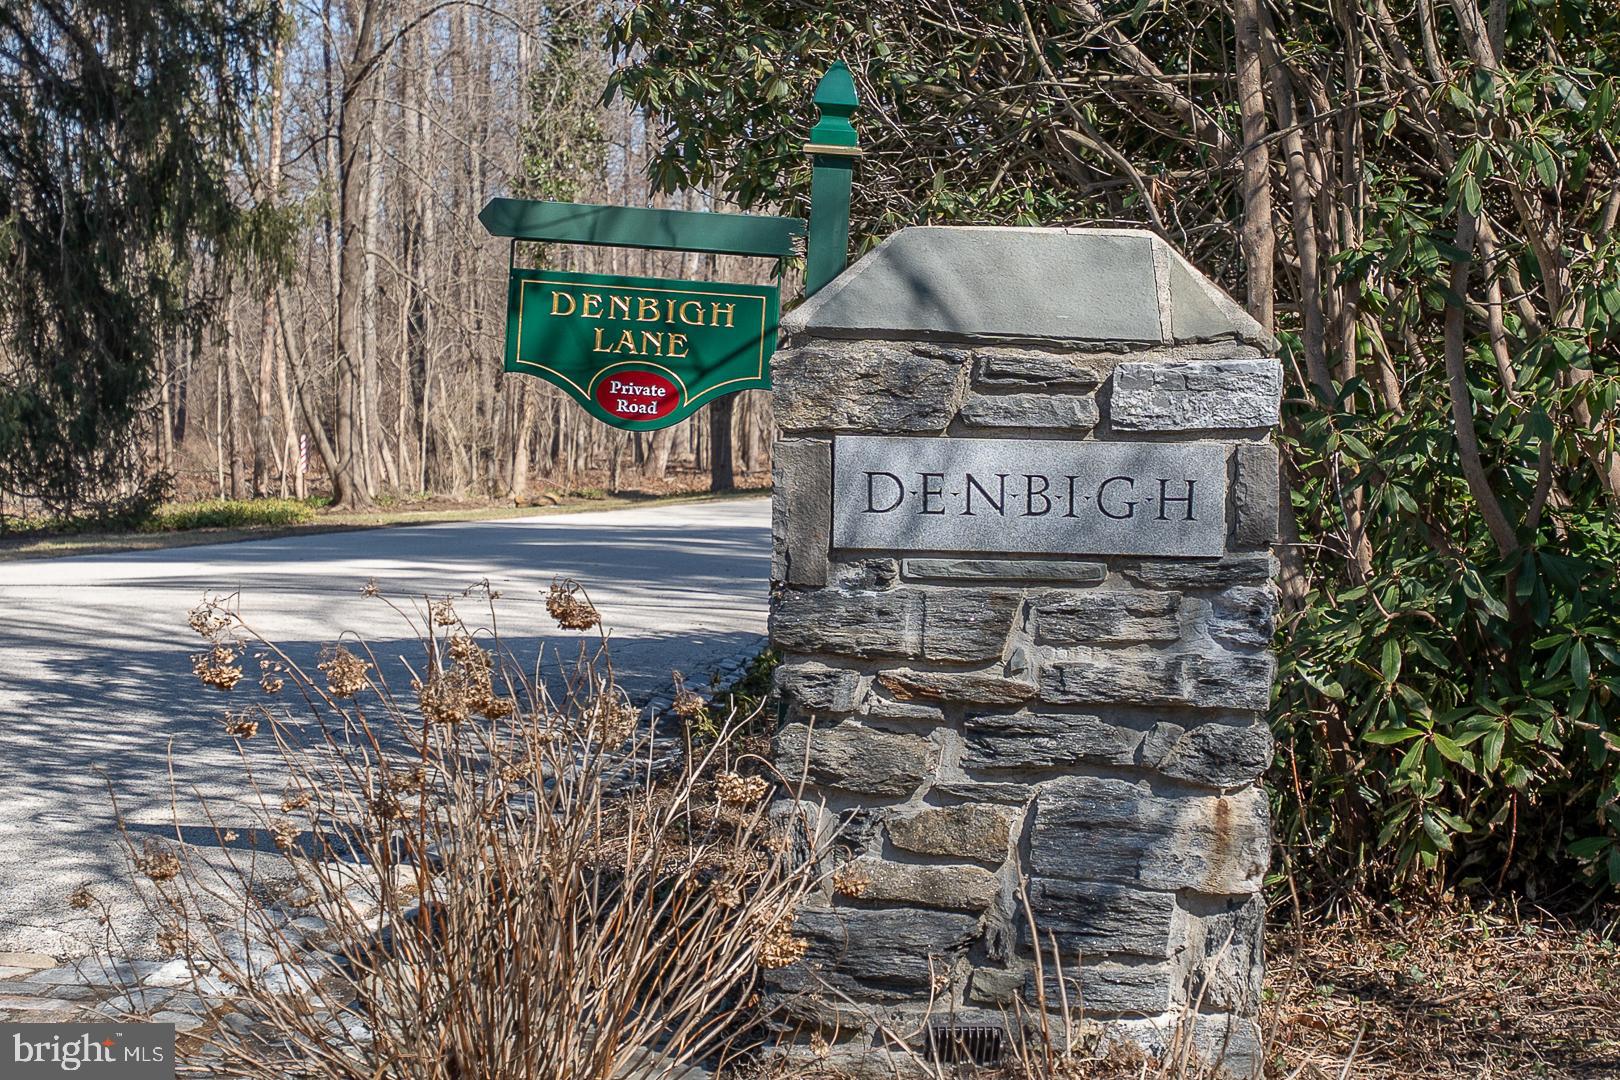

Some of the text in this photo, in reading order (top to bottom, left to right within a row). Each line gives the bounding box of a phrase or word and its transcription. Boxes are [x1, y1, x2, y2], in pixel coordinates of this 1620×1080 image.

[549, 290, 736, 328] DENBIGH
[593, 327, 690, 358] LANE
[609, 380, 667, 397] Private
[616, 399, 658, 415] Road
